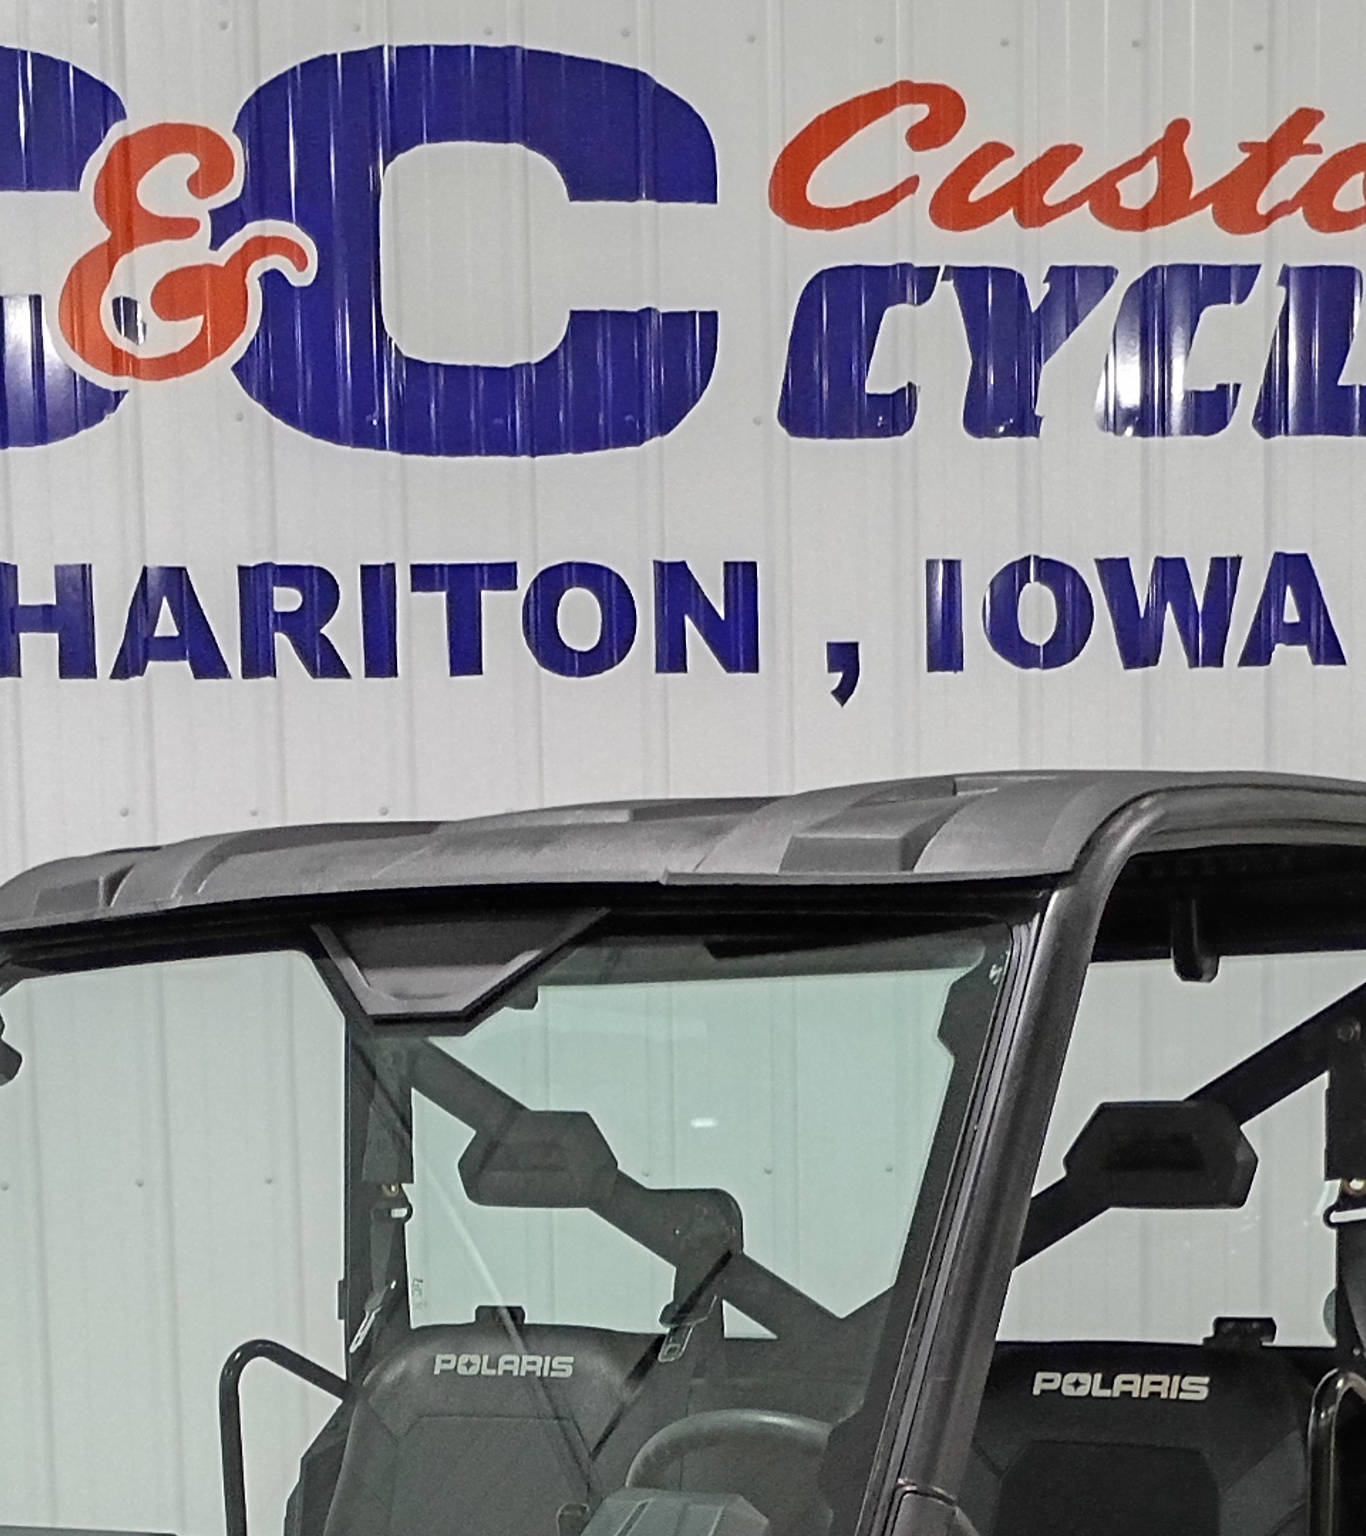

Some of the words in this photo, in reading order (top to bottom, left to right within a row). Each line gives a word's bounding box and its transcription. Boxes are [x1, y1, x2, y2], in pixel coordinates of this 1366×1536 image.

[926, 552, 1346, 673] IOWA
[433, 1354, 574, 1378] POLARIS
[1032, 1372, 1210, 1400] POLARIS
